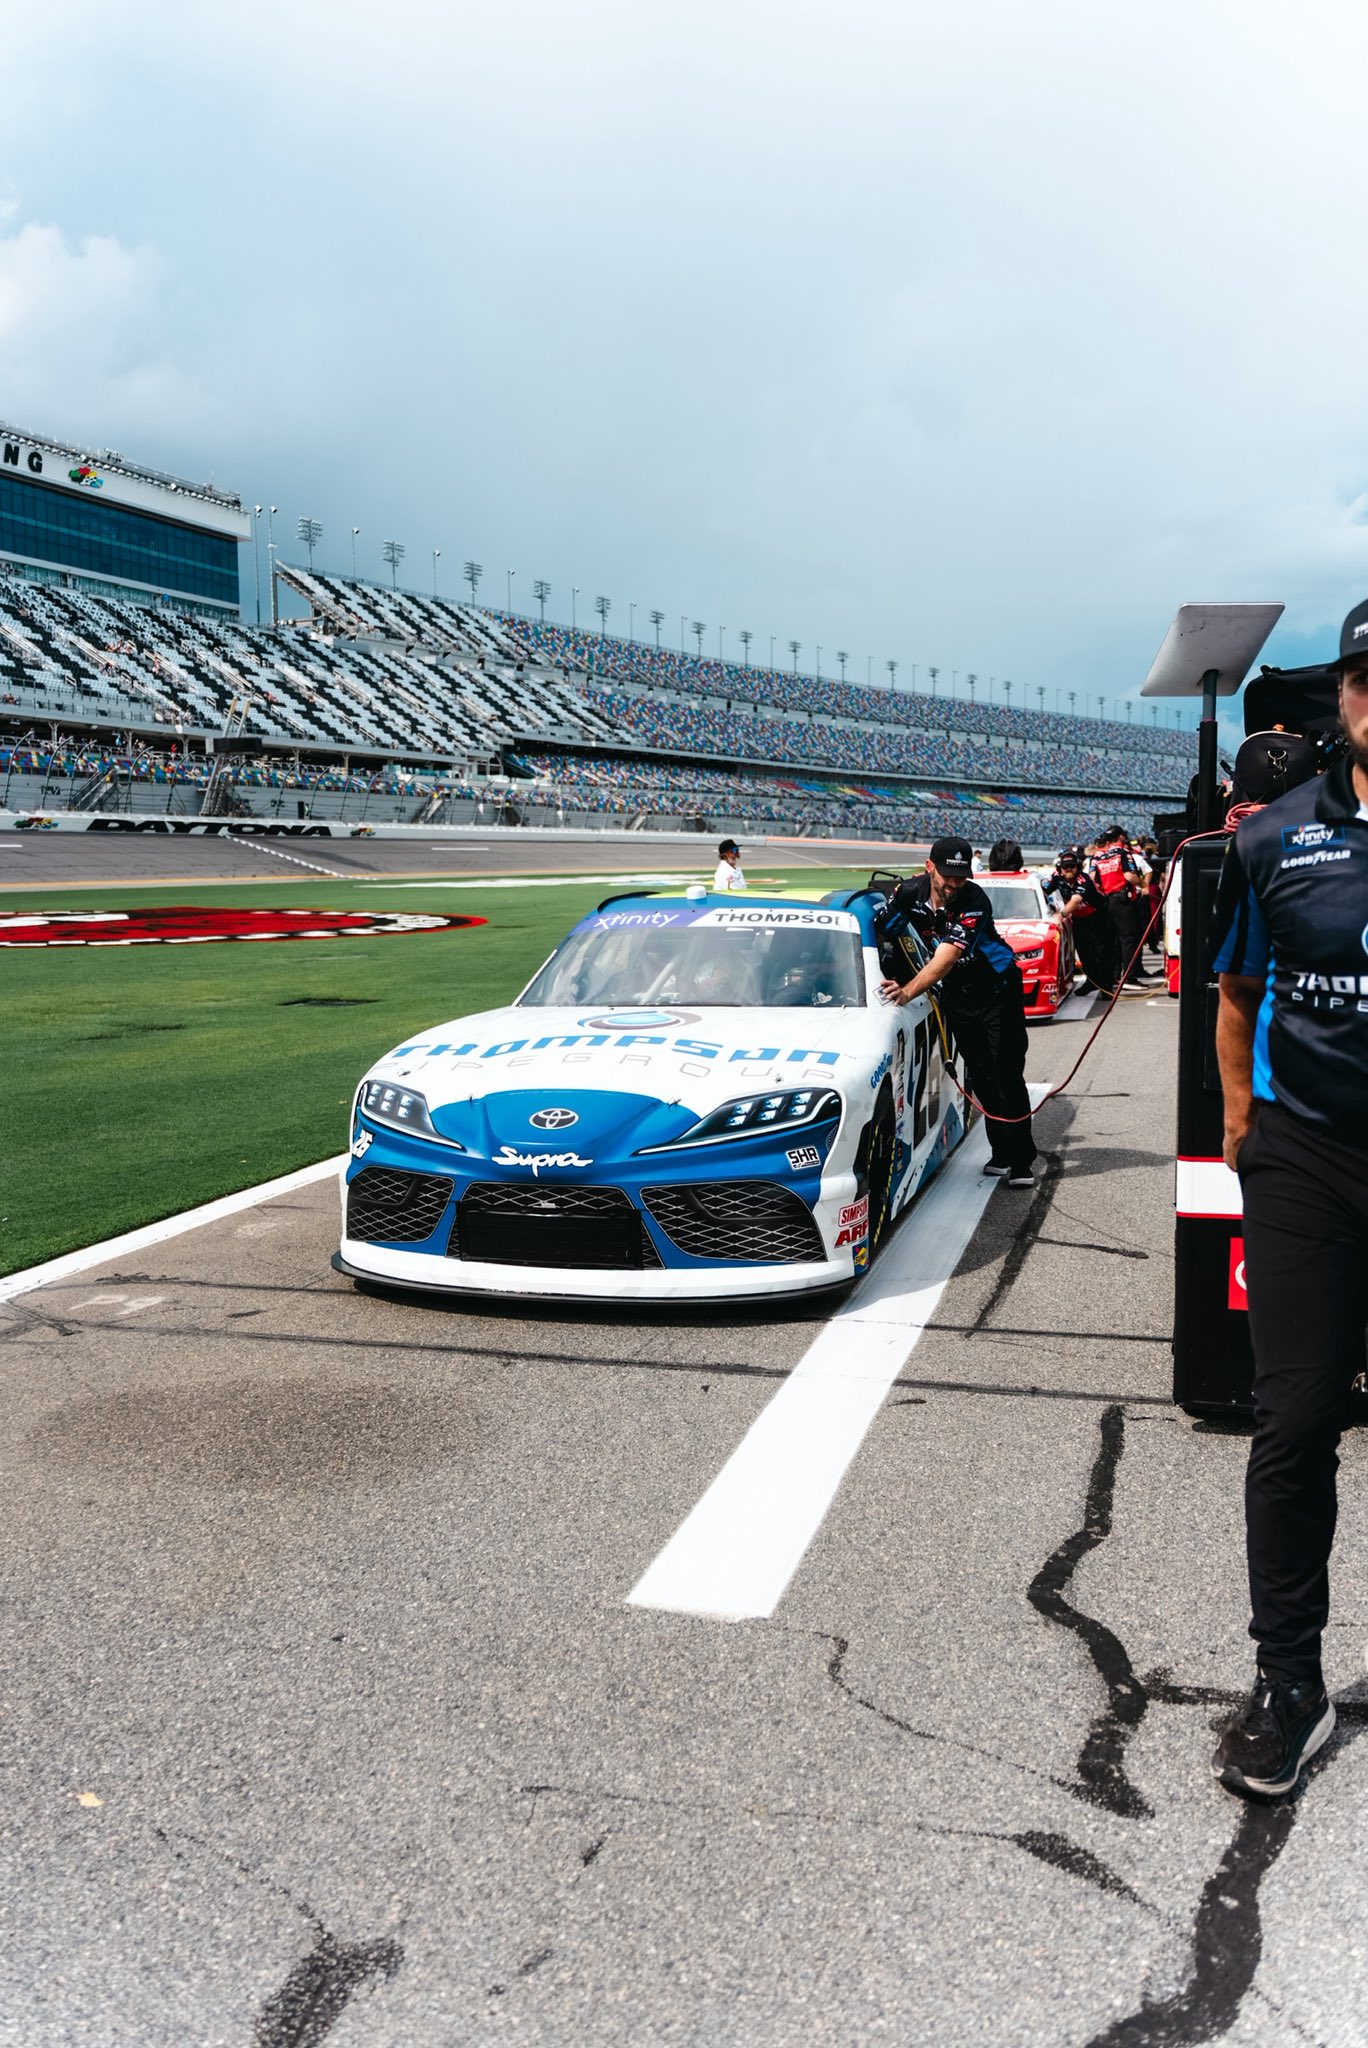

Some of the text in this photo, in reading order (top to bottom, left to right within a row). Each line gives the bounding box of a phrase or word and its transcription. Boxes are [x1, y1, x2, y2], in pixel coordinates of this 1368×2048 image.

[86, 818, 333, 837] DAYTONA
[1292, 828, 1335, 846] xfinity
[1281, 849, 1352, 869] GOODYEAR
[592, 911, 680, 930] xfinity
[714, 912, 841, 926] THOMPSO
[391, 1034, 842, 1066] THOMPSON
[492, 1146, 594, 1178] Supra
[787, 1147, 819, 1165] SHR
